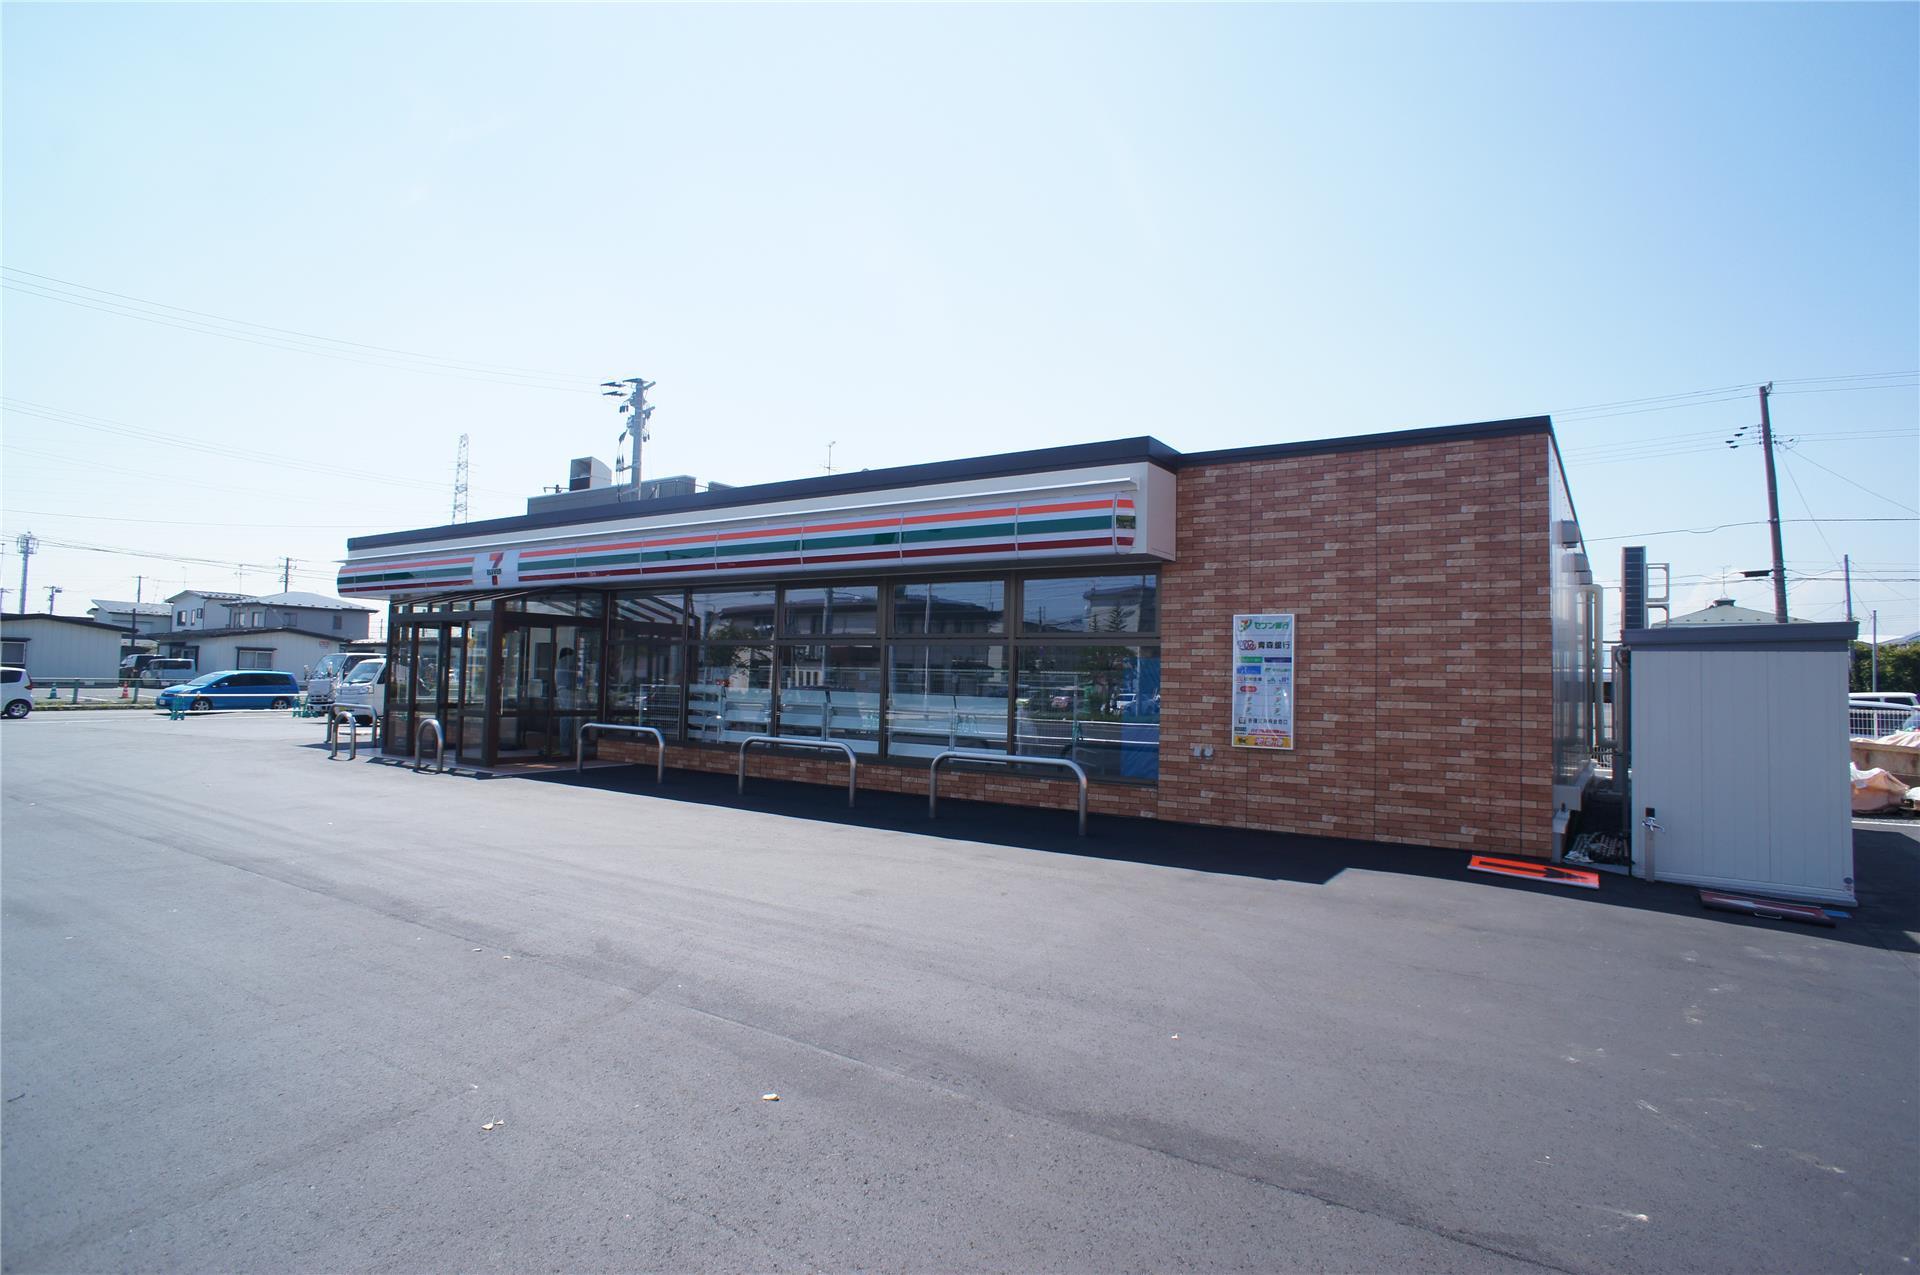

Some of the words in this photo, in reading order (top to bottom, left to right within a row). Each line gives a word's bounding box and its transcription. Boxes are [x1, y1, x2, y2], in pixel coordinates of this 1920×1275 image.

[489, 552, 504, 585] 7
[1258, 640, 1290, 649] 青森銀行
